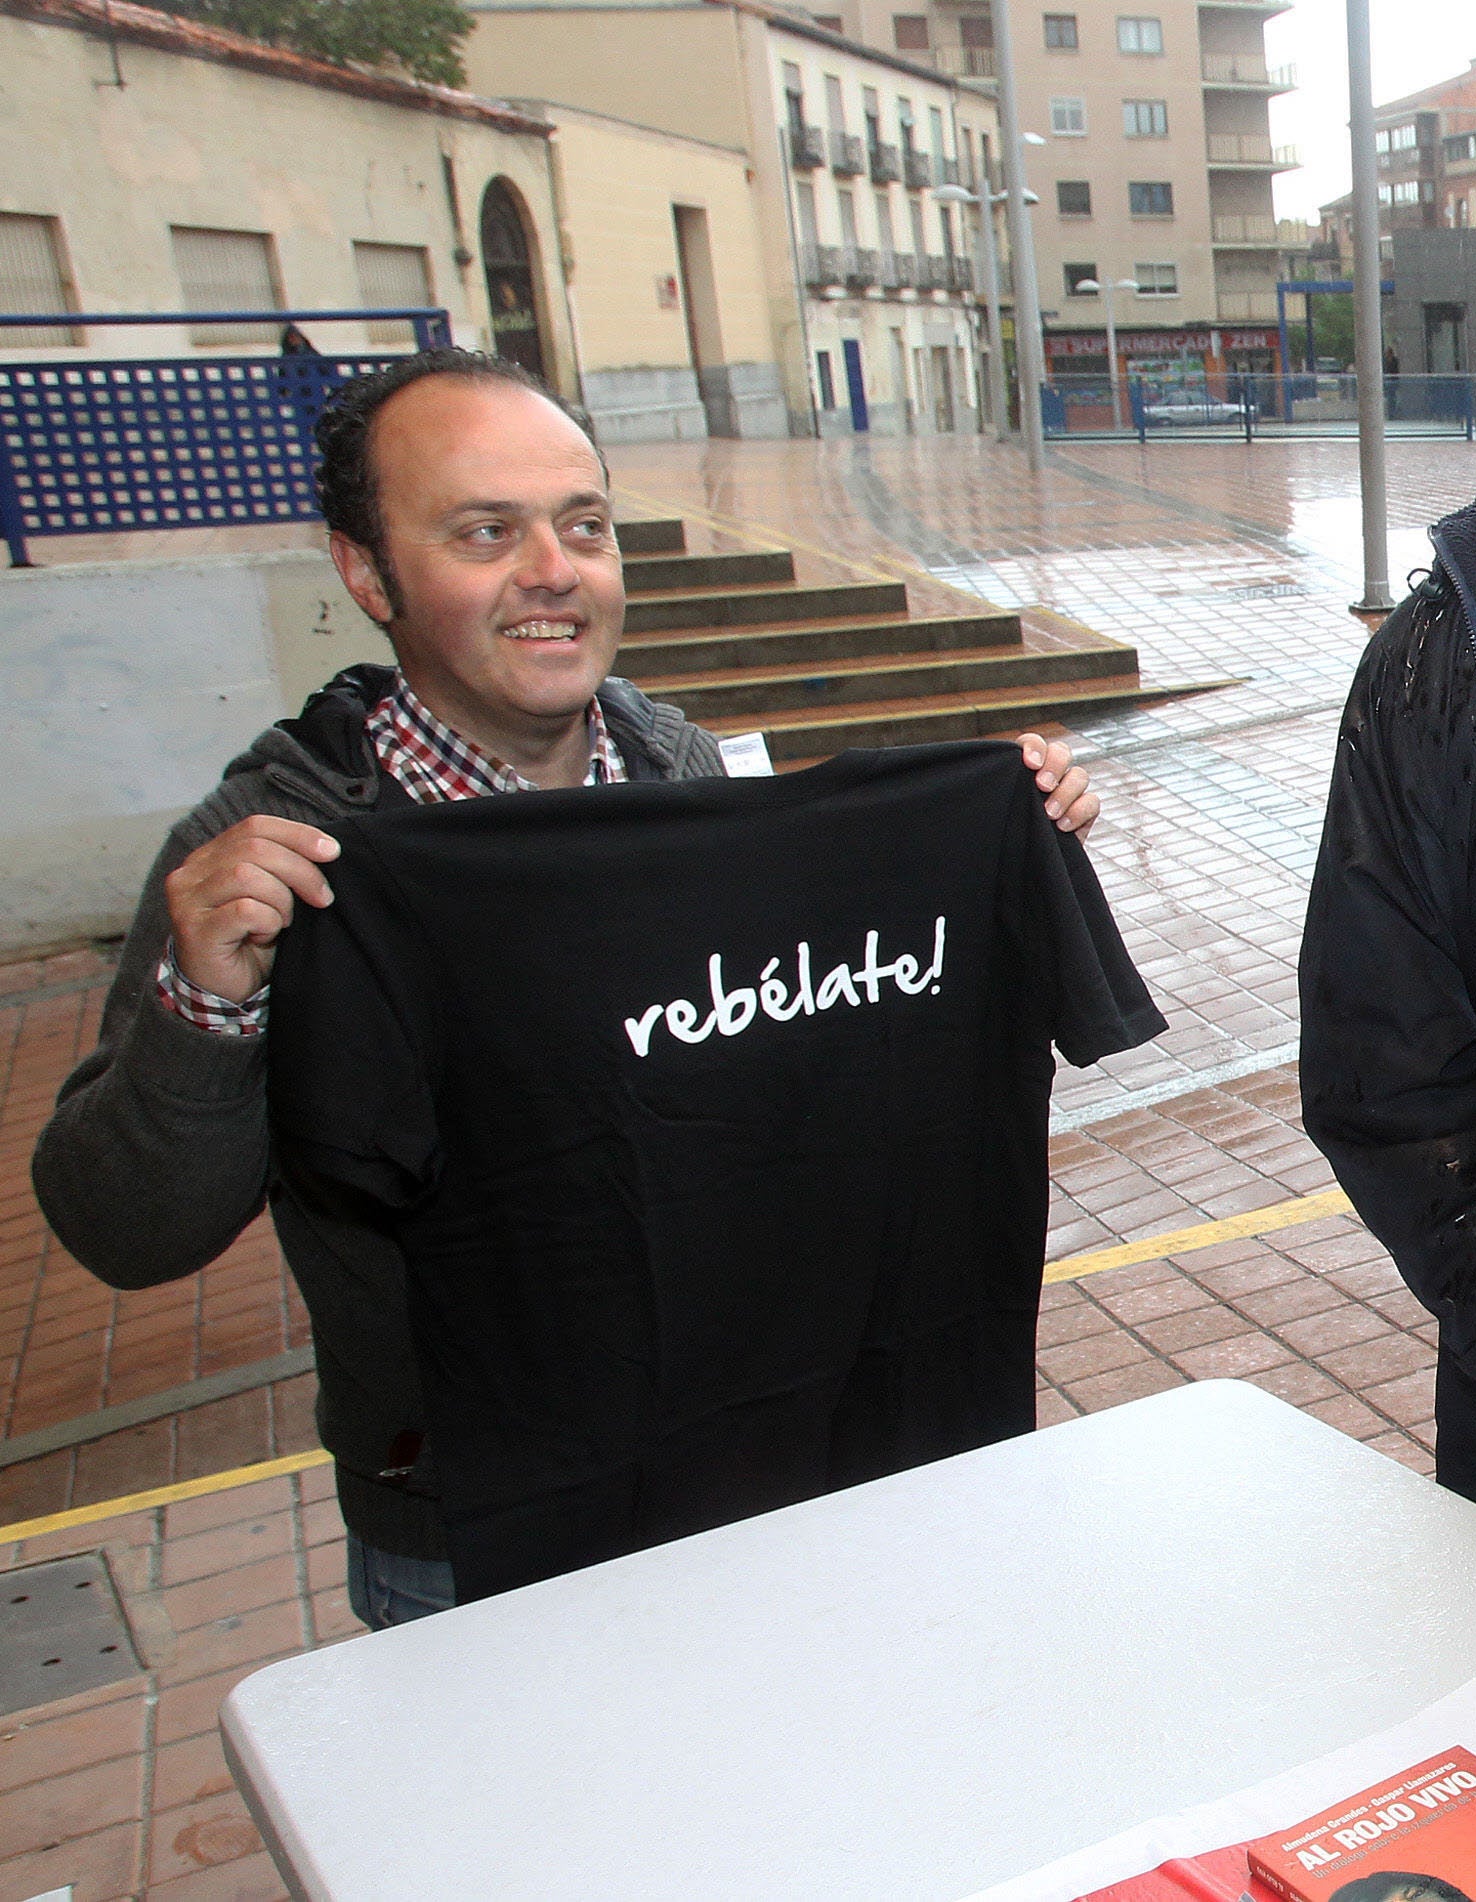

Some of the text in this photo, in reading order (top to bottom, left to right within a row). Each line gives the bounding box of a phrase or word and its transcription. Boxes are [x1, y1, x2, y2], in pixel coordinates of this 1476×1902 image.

[1071, 336, 1221, 353] SUPRMERCAD
[1231, 333, 1266, 348] ZEN
[624, 915, 946, 1058] rebélate!
[1281, 1825, 1330, 1853] Almudena
[1327, 1805, 1369, 1829] Grandes
[1371, 1787, 1405, 1807] Gaspar
[1402, 1762, 1457, 1790] Llamazares
[1295, 1843, 1342, 1871] AL
[1332, 1803, 1416, 1850] ROJO
